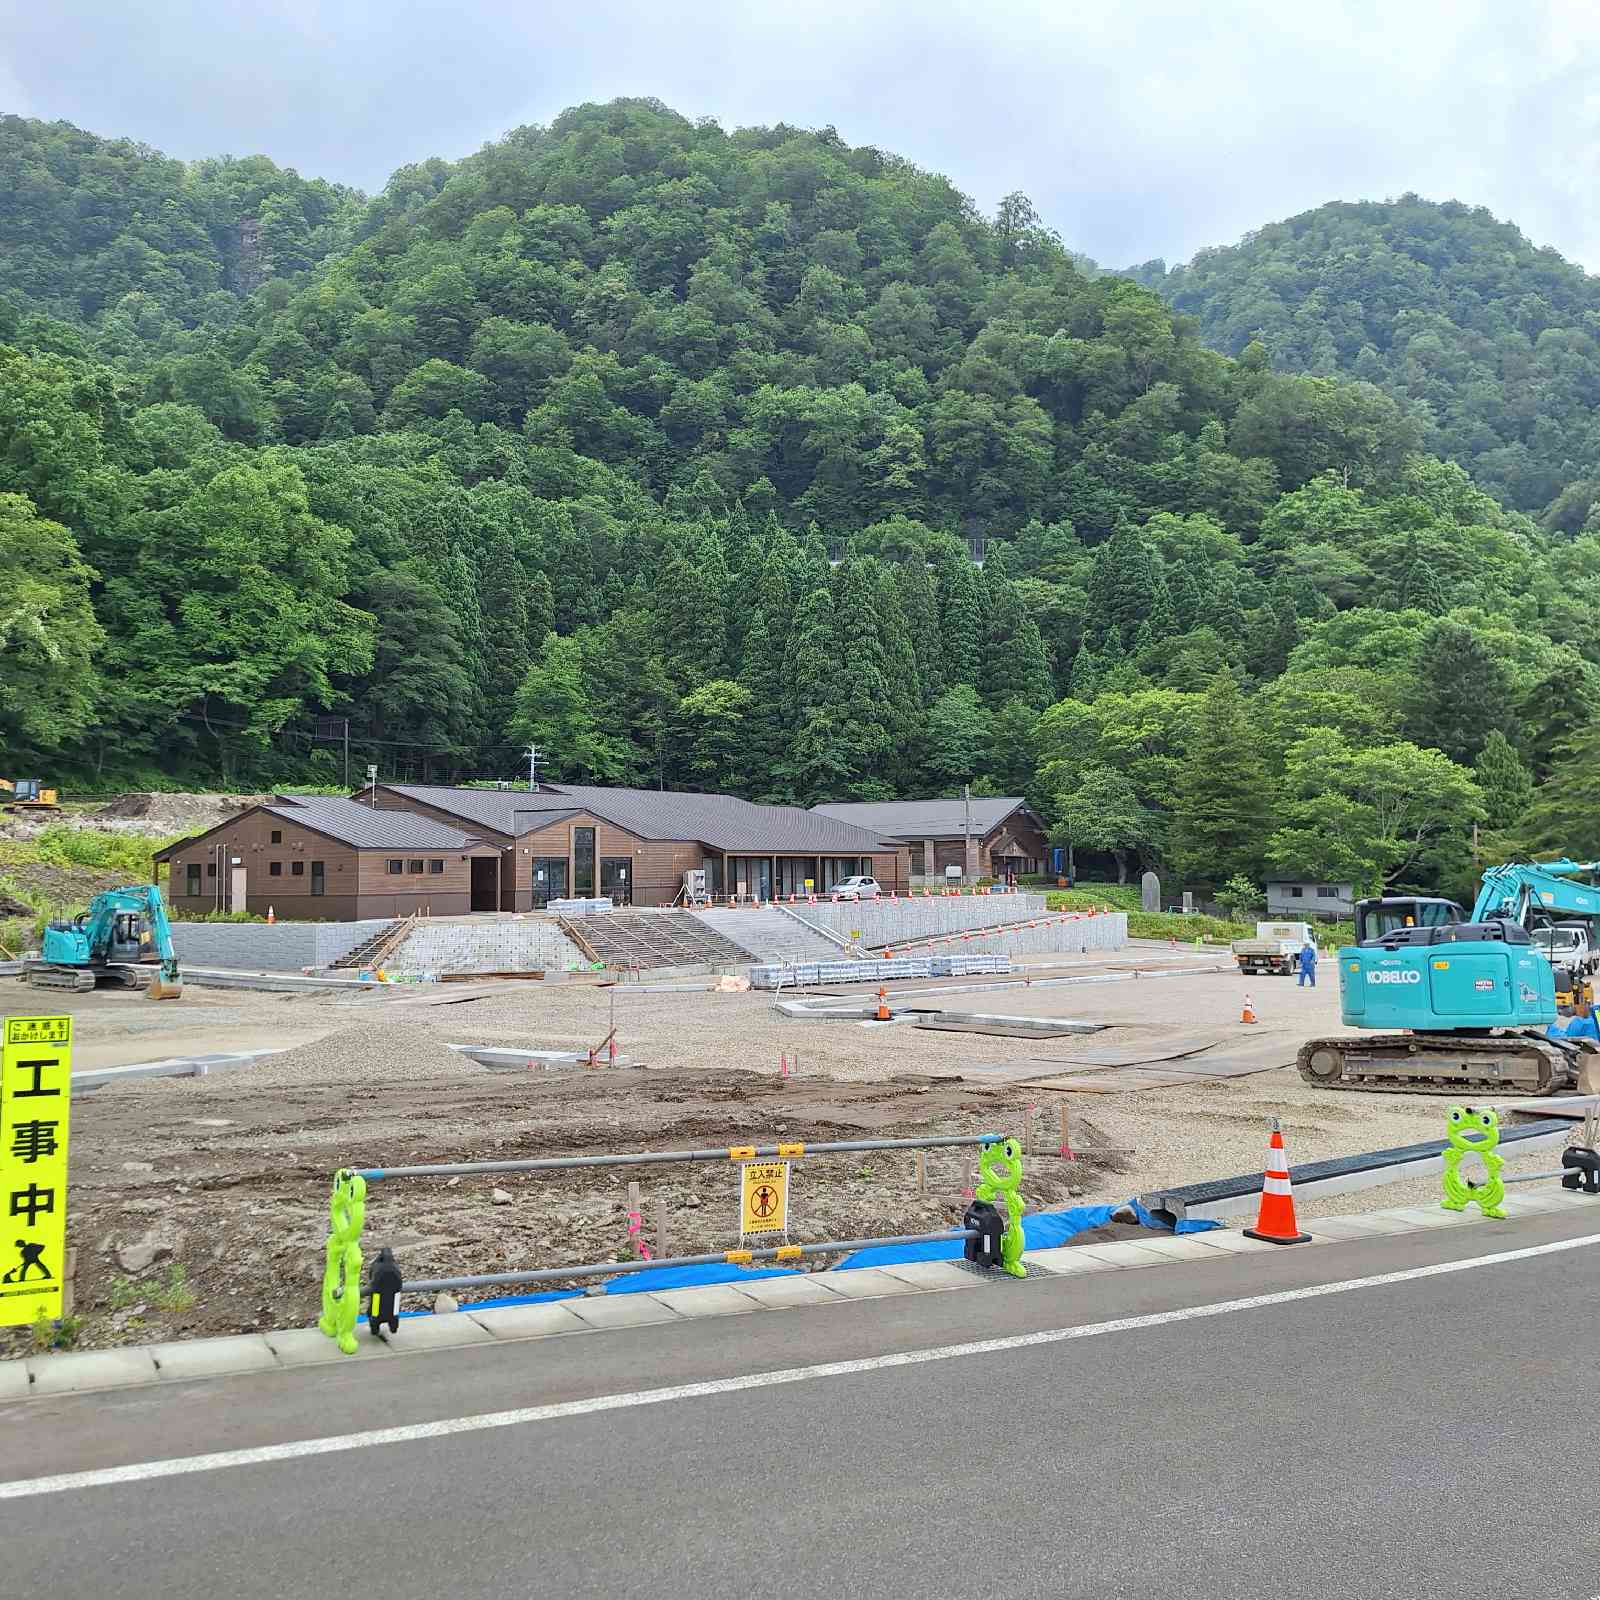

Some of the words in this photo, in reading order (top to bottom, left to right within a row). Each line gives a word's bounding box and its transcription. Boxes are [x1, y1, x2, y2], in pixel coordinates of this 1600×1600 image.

[1366, 970, 1420, 984] KOBELCO
[10, 1059, 60, 1226] 工事中
[749, 1168, 783, 1180] 立入禁止
